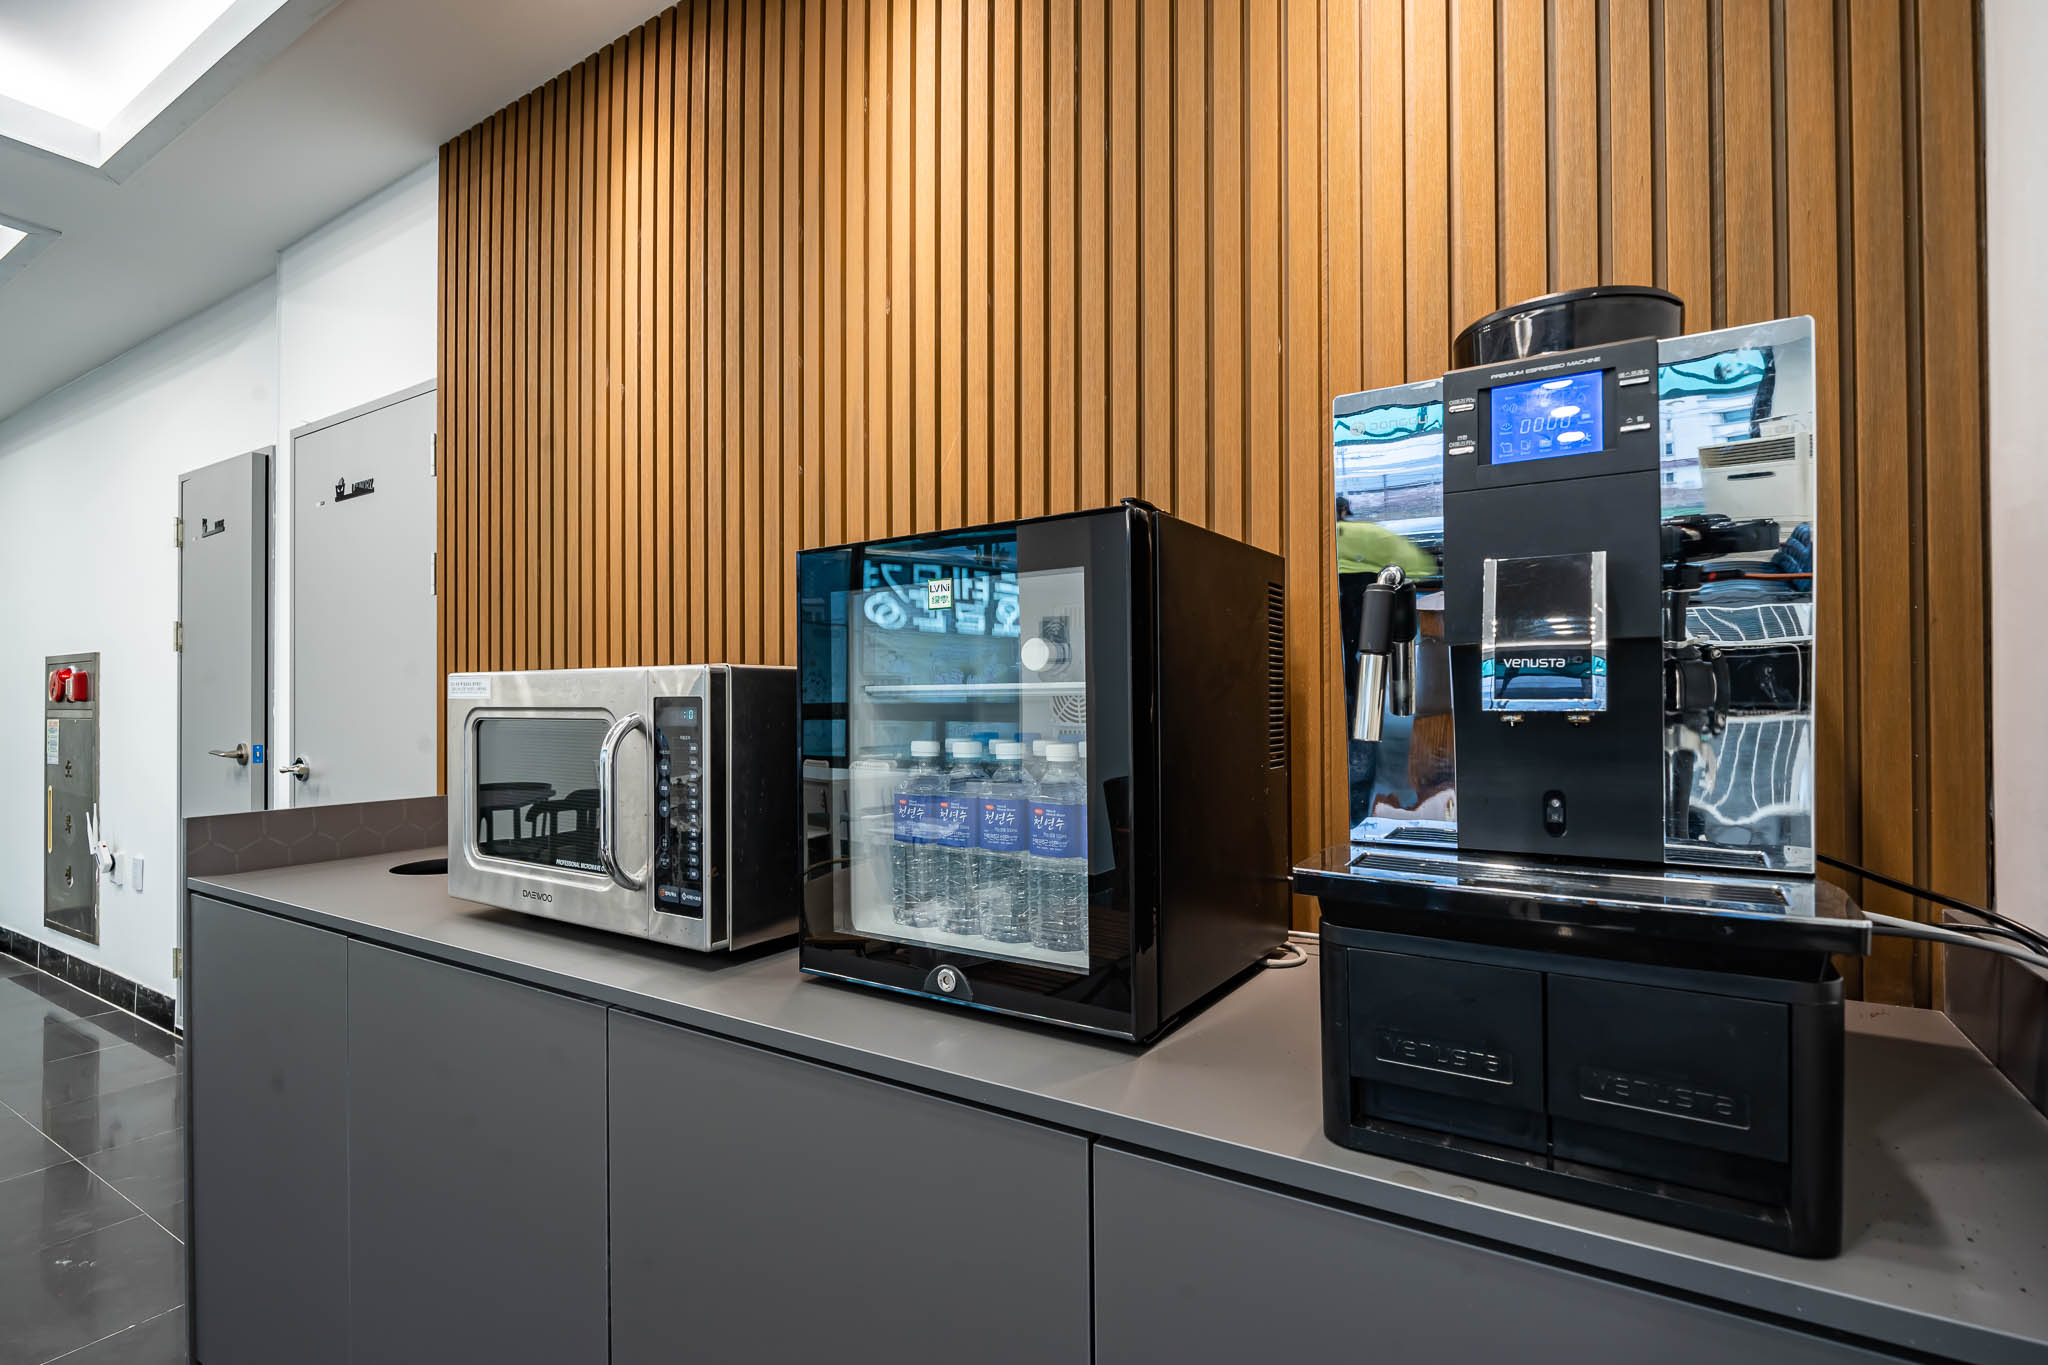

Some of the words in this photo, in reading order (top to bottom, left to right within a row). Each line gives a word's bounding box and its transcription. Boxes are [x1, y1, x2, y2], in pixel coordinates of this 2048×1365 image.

[1490, 369, 1524, 380] PREMIUM
[1525, 362, 1565, 374] ESPRESSO
[1566, 356, 1601, 367] MACHINE
[522, 889, 553, 903] DAEWOO
